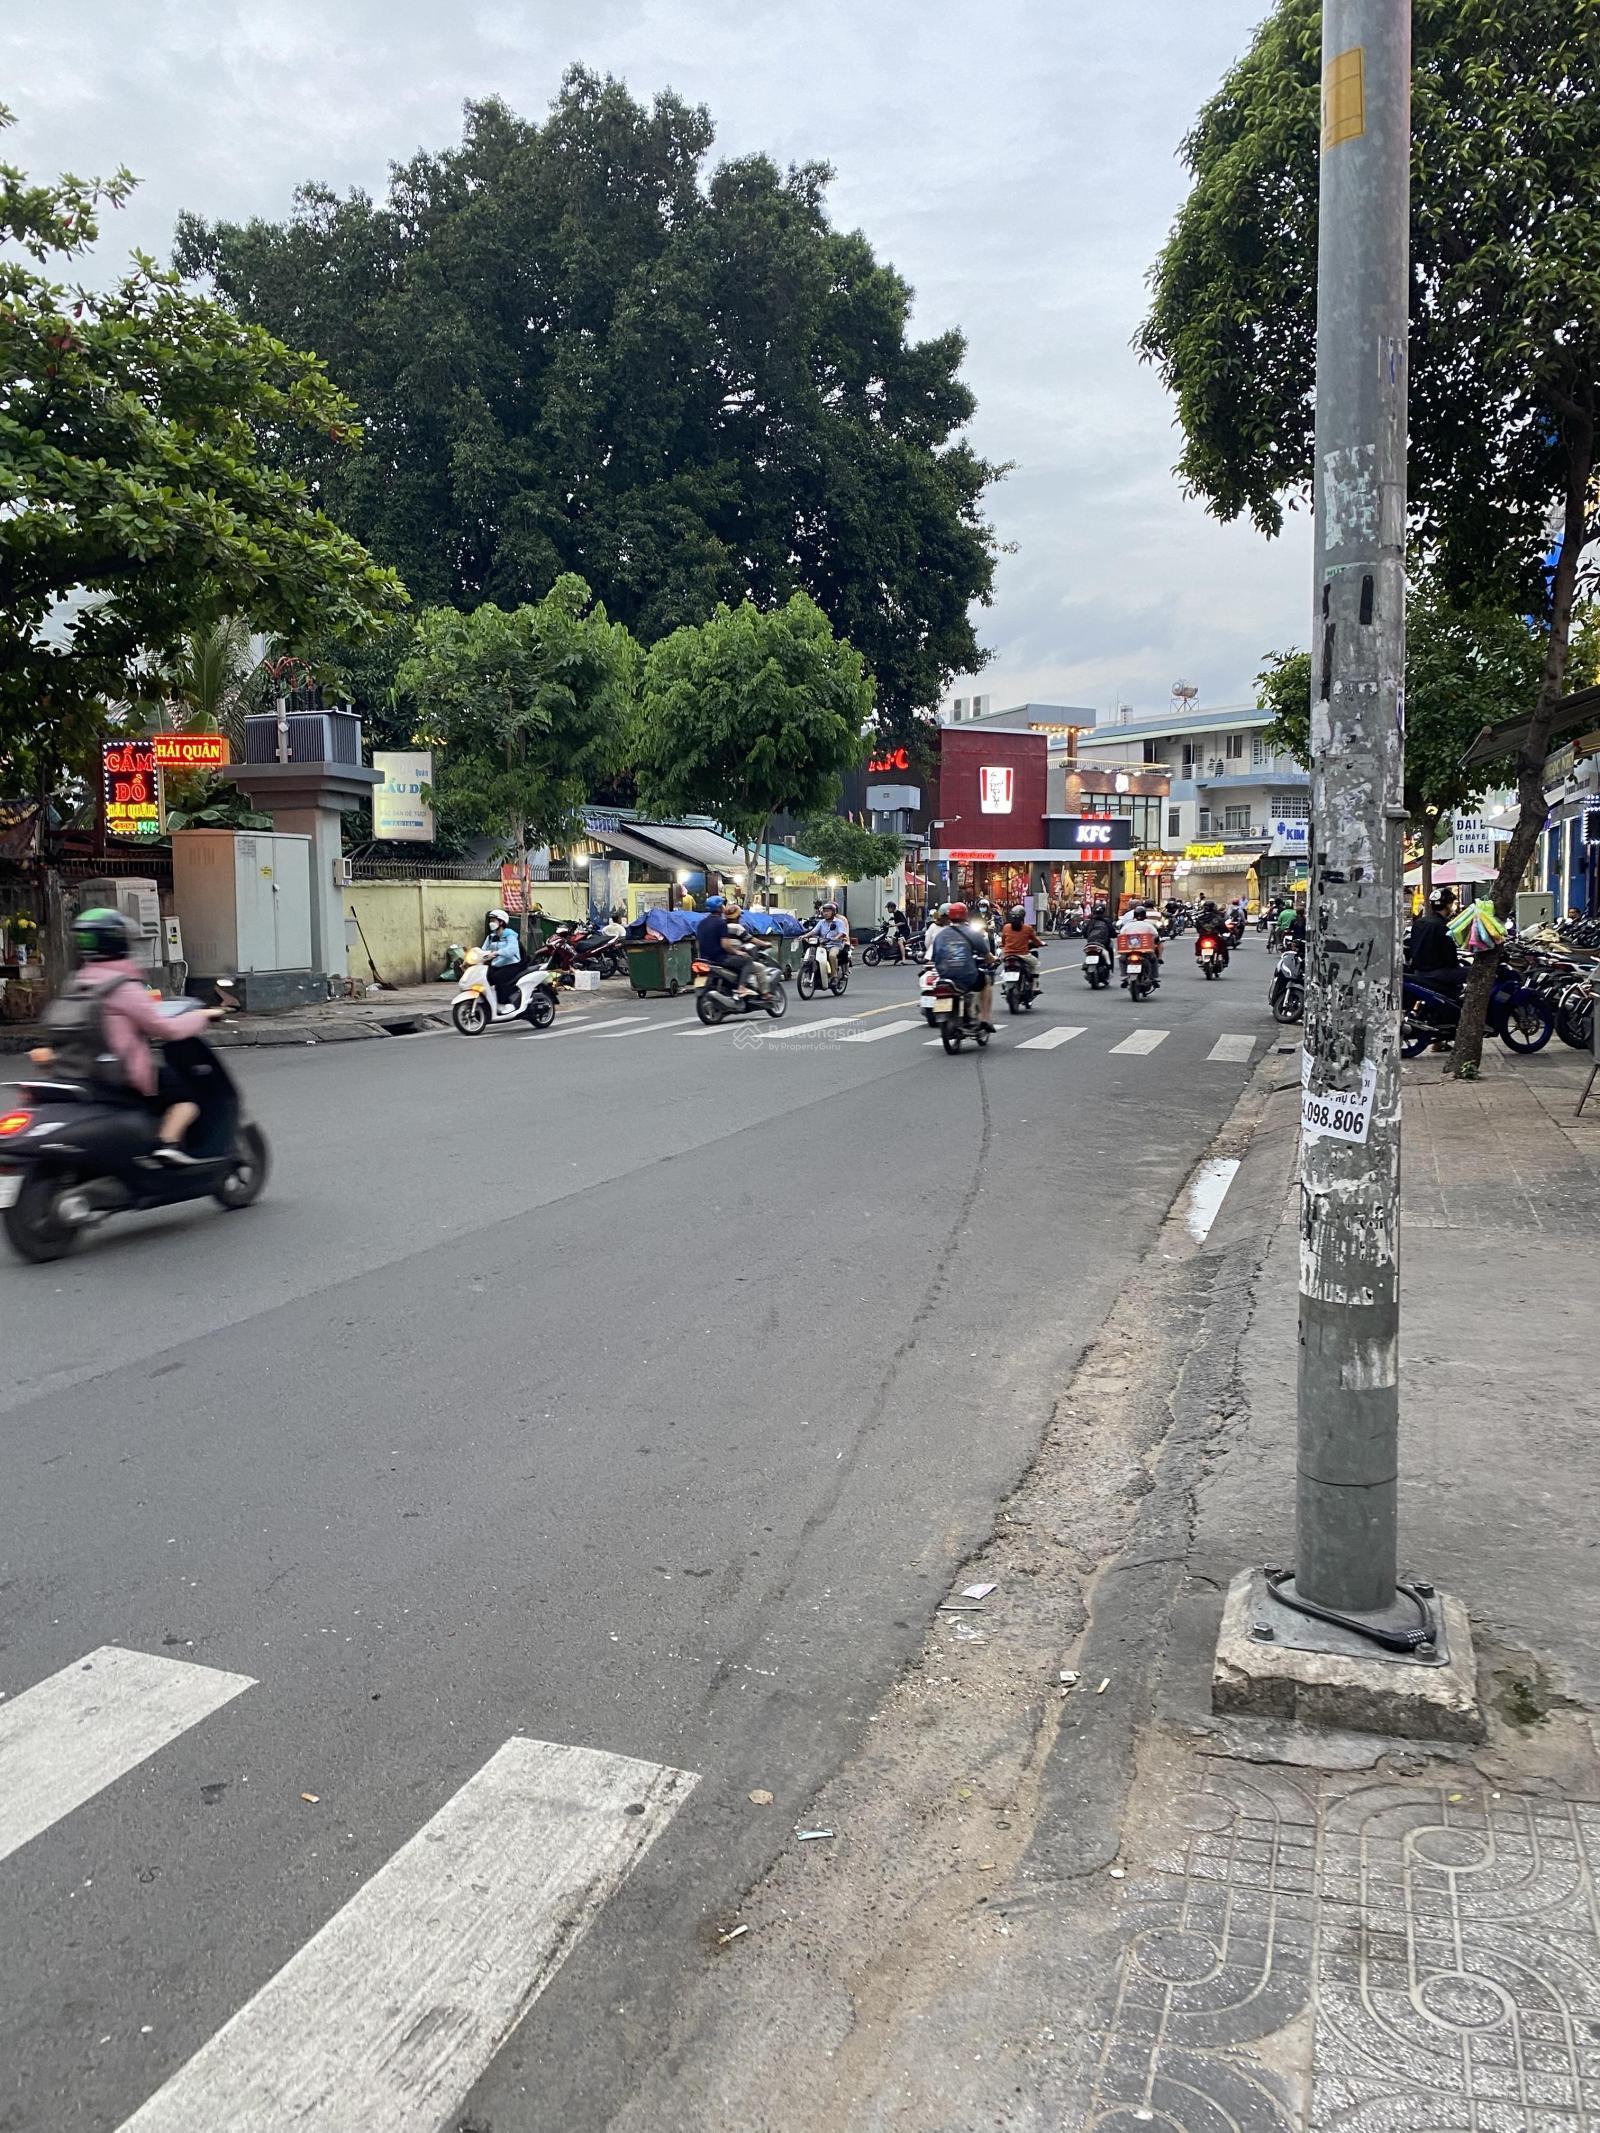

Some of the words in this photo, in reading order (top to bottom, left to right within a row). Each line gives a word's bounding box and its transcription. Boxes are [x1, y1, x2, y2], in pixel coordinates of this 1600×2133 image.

[157, 741, 181, 758] HẢI
[183, 743, 220, 760] QUÂN
[1457, 820, 1476, 831] ĐẠI
[1076, 825, 1111, 843] KFC
[1286, 829, 1305, 840] KIM
[1459, 842, 1475, 854] GIÁ
